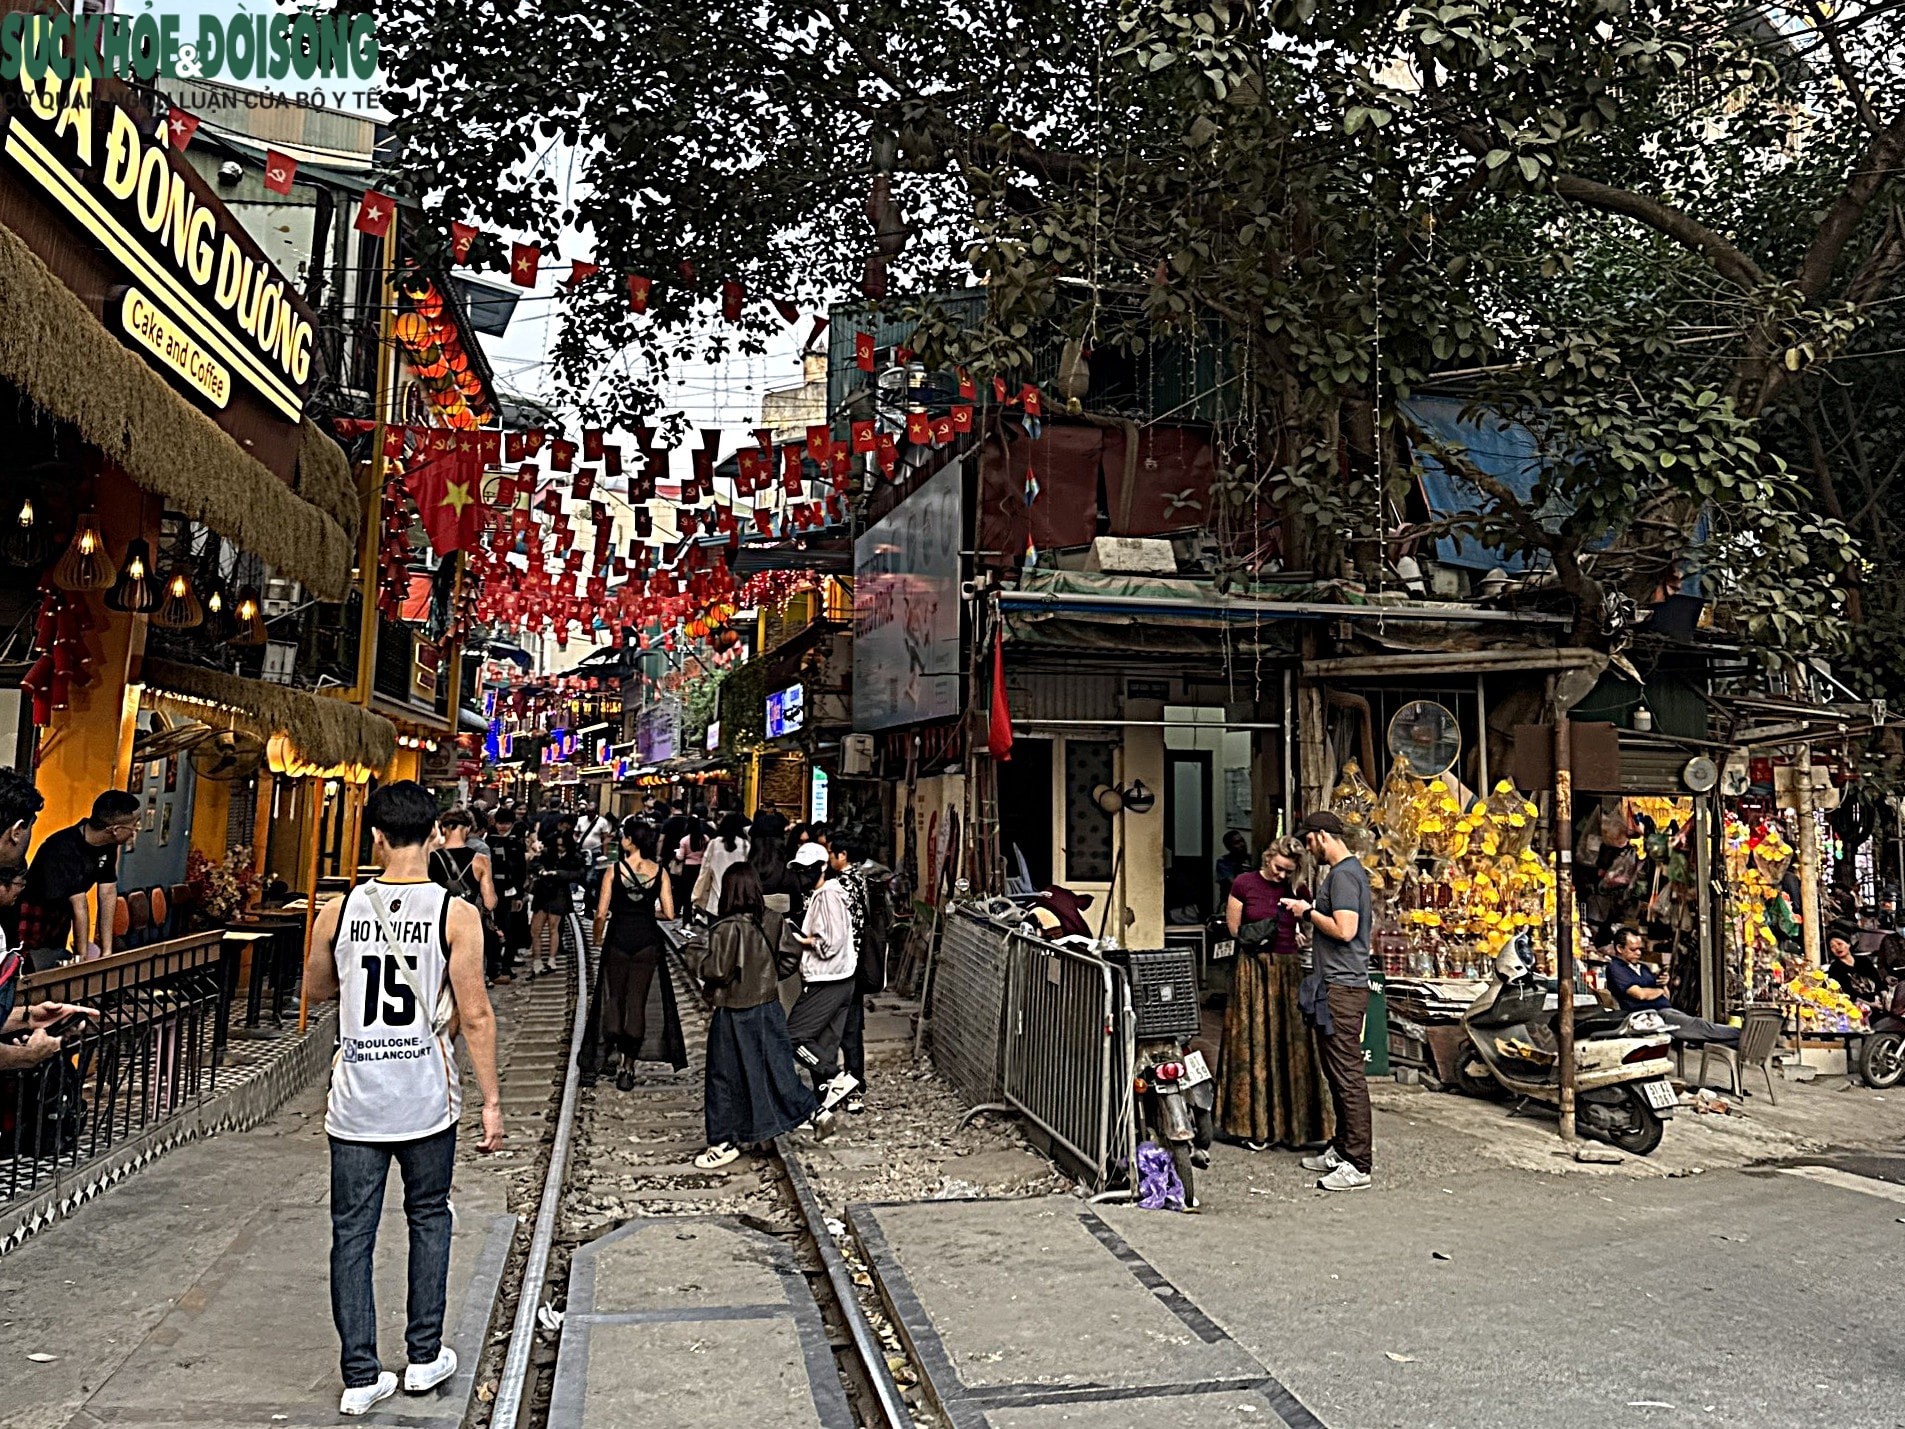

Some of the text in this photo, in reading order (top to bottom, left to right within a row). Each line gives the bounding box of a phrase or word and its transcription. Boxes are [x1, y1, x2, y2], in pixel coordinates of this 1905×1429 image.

[103, 104, 217, 286] ĐÔNG
[214, 234, 313, 385] DƯƠNG
[132, 299, 223, 398] Cake and Coffee
[350, 920, 371, 942] HO
[403, 921, 432, 943] FAT
[361, 954, 417, 1026] 15
[357, 1037, 423, 1049] BOULOGNE-
[357, 1046, 431, 1062] BILLANCOURT
